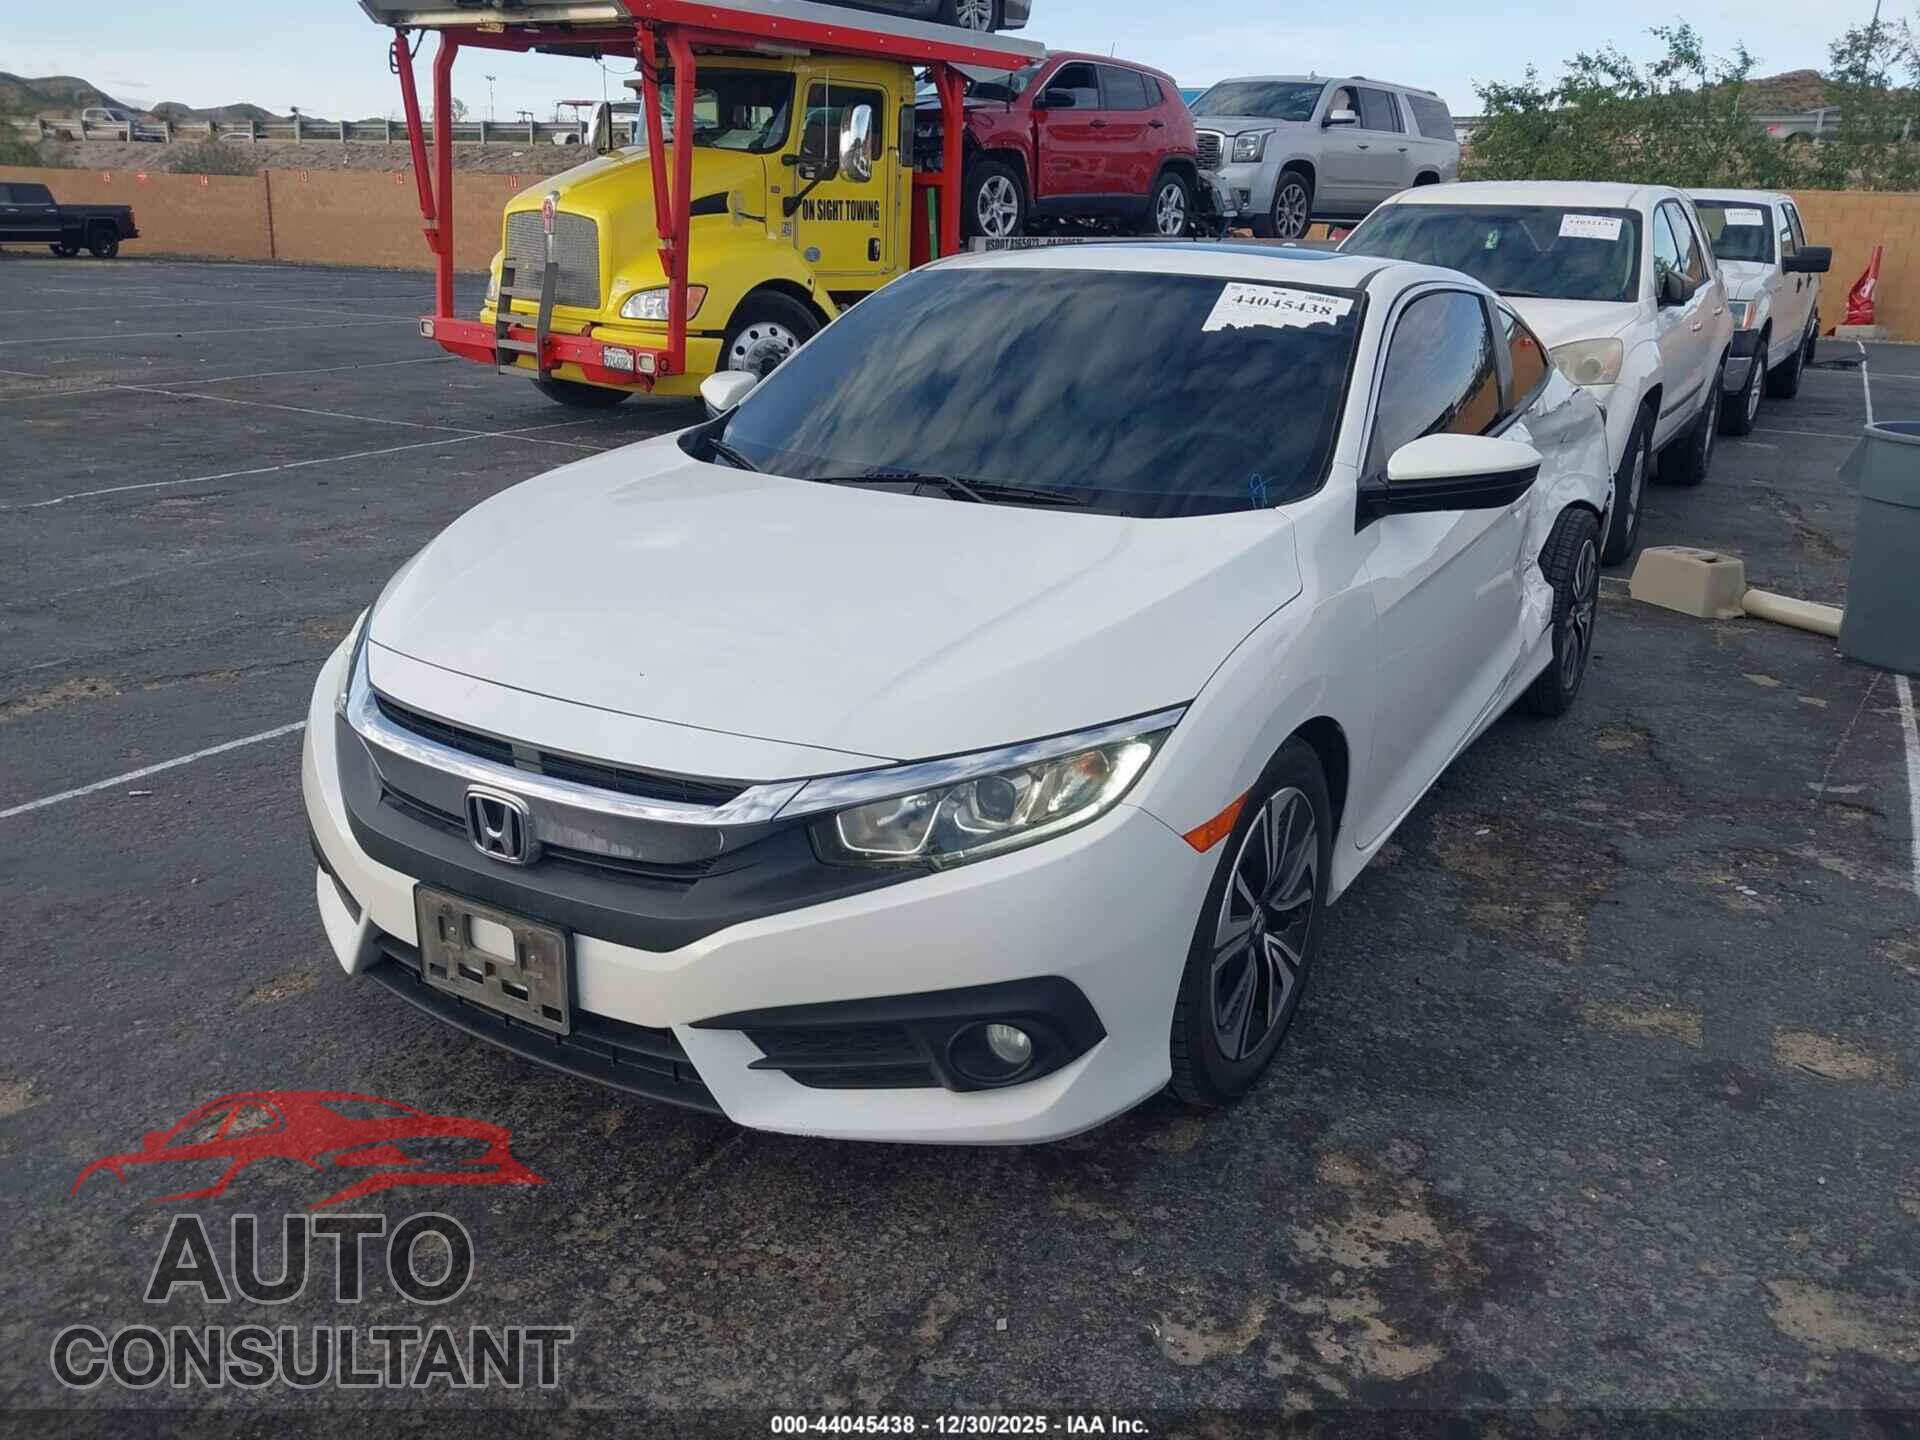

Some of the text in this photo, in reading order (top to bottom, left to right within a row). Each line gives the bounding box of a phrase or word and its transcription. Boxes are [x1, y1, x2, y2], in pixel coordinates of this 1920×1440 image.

[802, 199, 880, 221] ON SIGHT TOWING
[1231, 294, 1333, 316] 44045438
